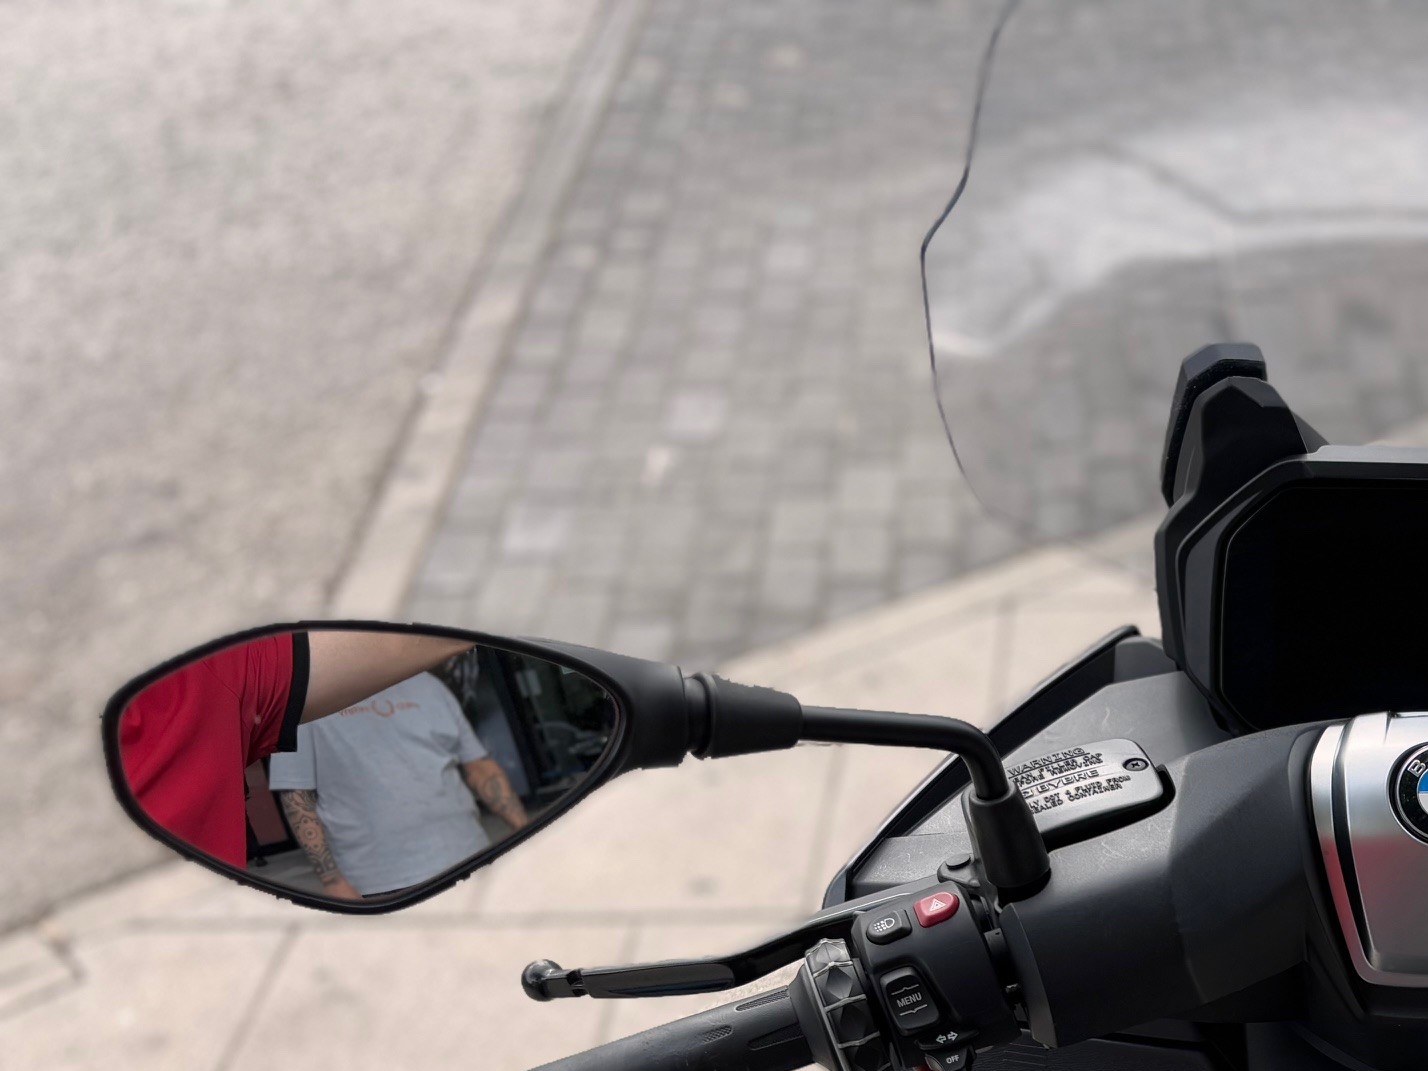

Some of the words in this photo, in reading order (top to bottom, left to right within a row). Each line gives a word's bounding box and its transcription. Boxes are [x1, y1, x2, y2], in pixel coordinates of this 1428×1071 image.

[1008, 747, 1085, 775] WARNING
[1105, 775, 1132, 784] FROM
[1068, 784, 1123, 801] CONTAINER
[897, 992, 922, 1008] MENU
[946, 1055, 959, 1064] OFF
